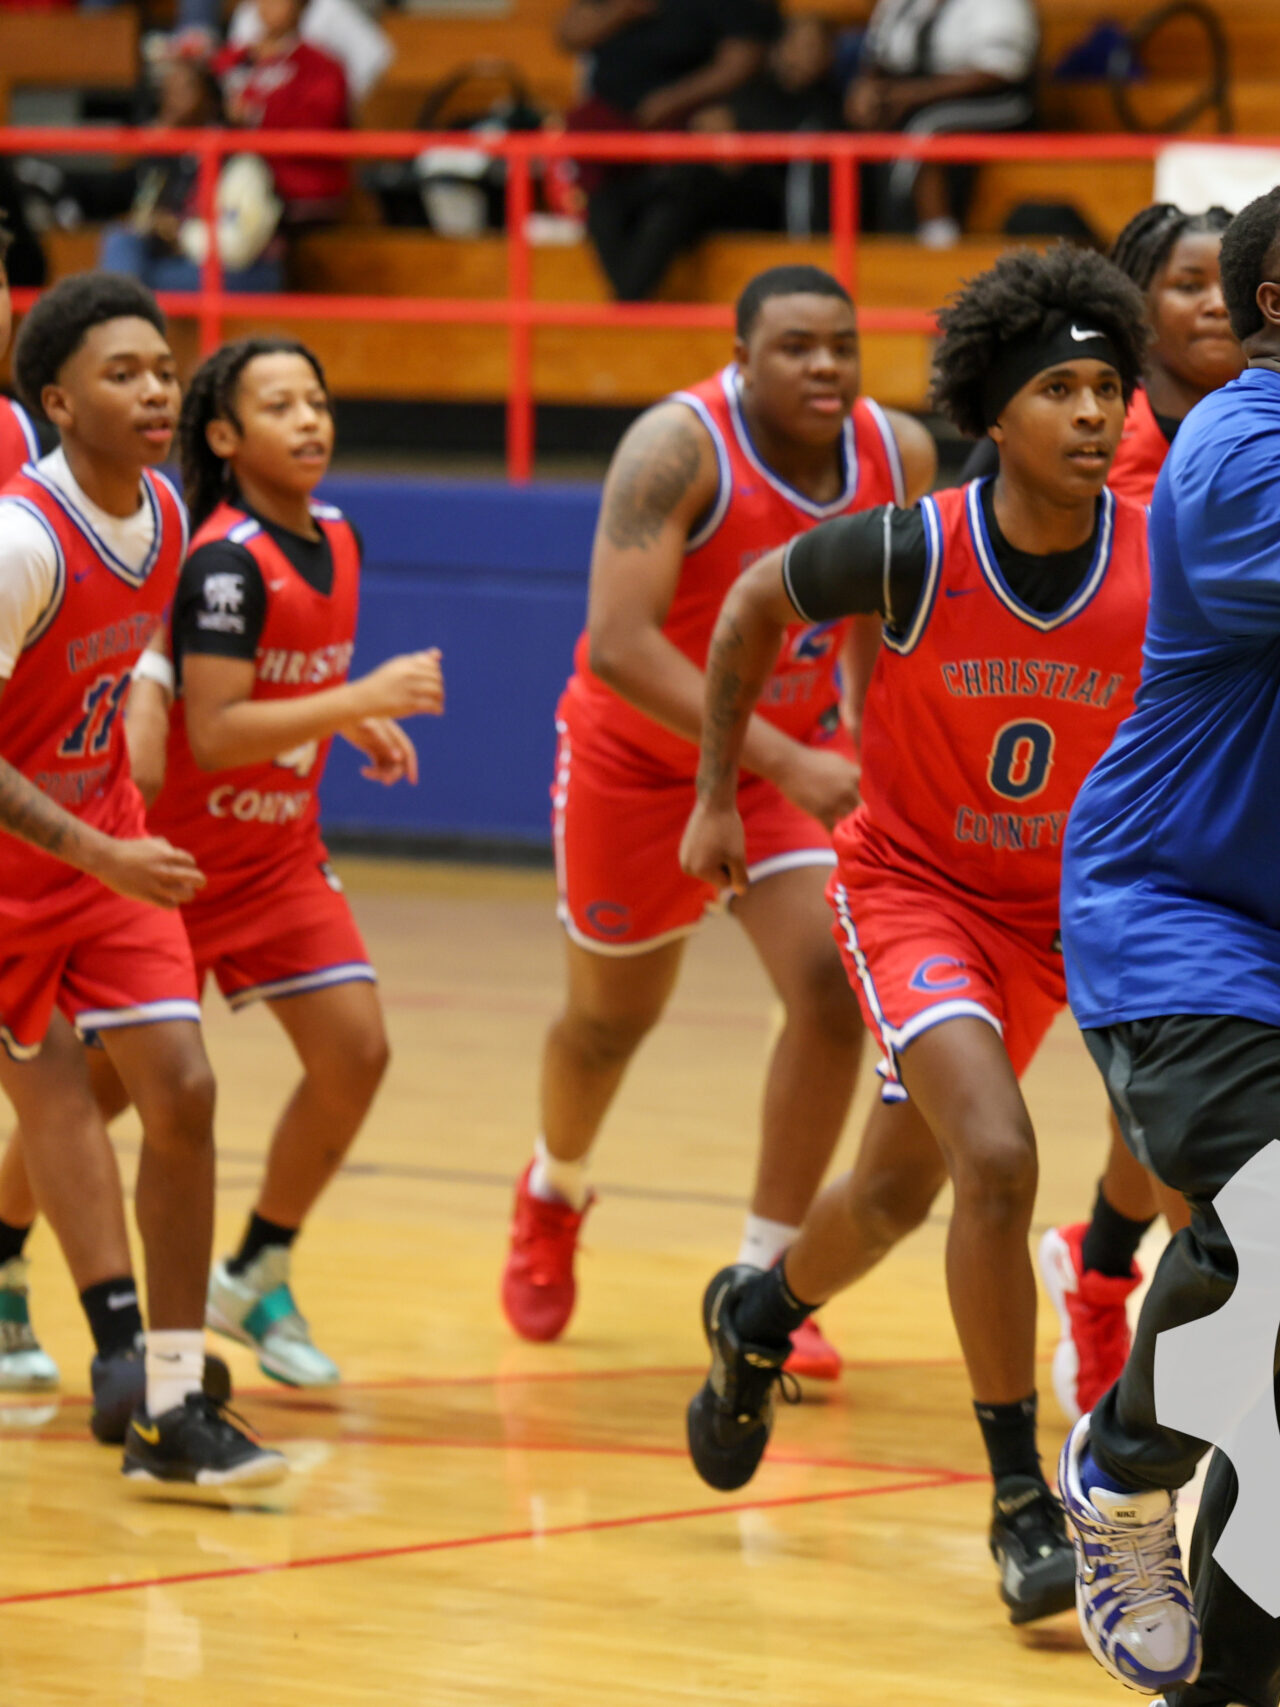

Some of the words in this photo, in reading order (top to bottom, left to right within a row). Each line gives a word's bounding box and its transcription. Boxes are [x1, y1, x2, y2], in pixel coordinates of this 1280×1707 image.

[57, 667, 132, 758] 11
[942, 657, 1124, 709] CHRISTIAN
[986, 717, 1056, 803] 0
[954, 804, 1069, 851] COUNTY
